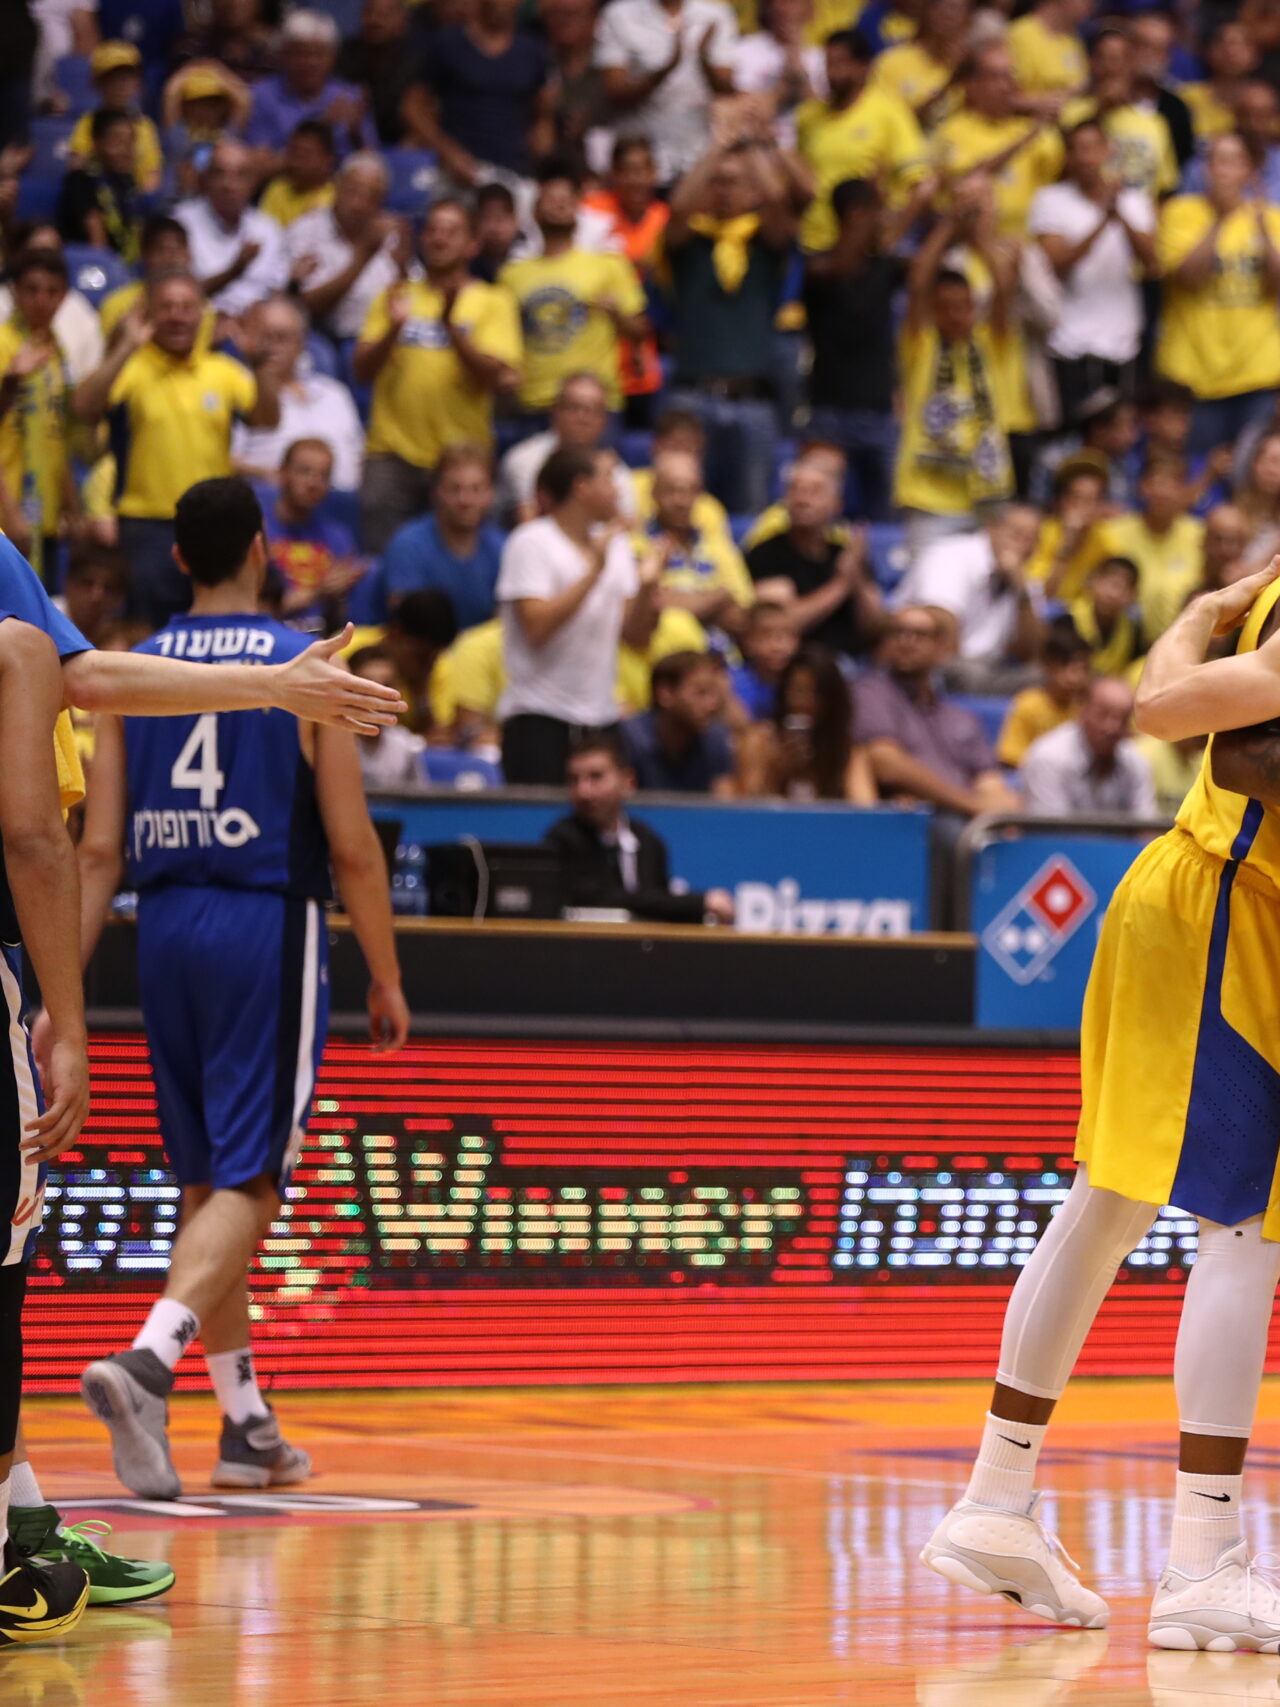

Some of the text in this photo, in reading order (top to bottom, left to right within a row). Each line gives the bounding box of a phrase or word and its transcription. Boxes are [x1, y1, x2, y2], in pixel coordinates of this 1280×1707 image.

[155, 626, 275, 658] משעור
[171, 712, 224, 810] 4
[735, 877, 911, 937] Pizza
[362, 1135, 802, 1267] Winner
